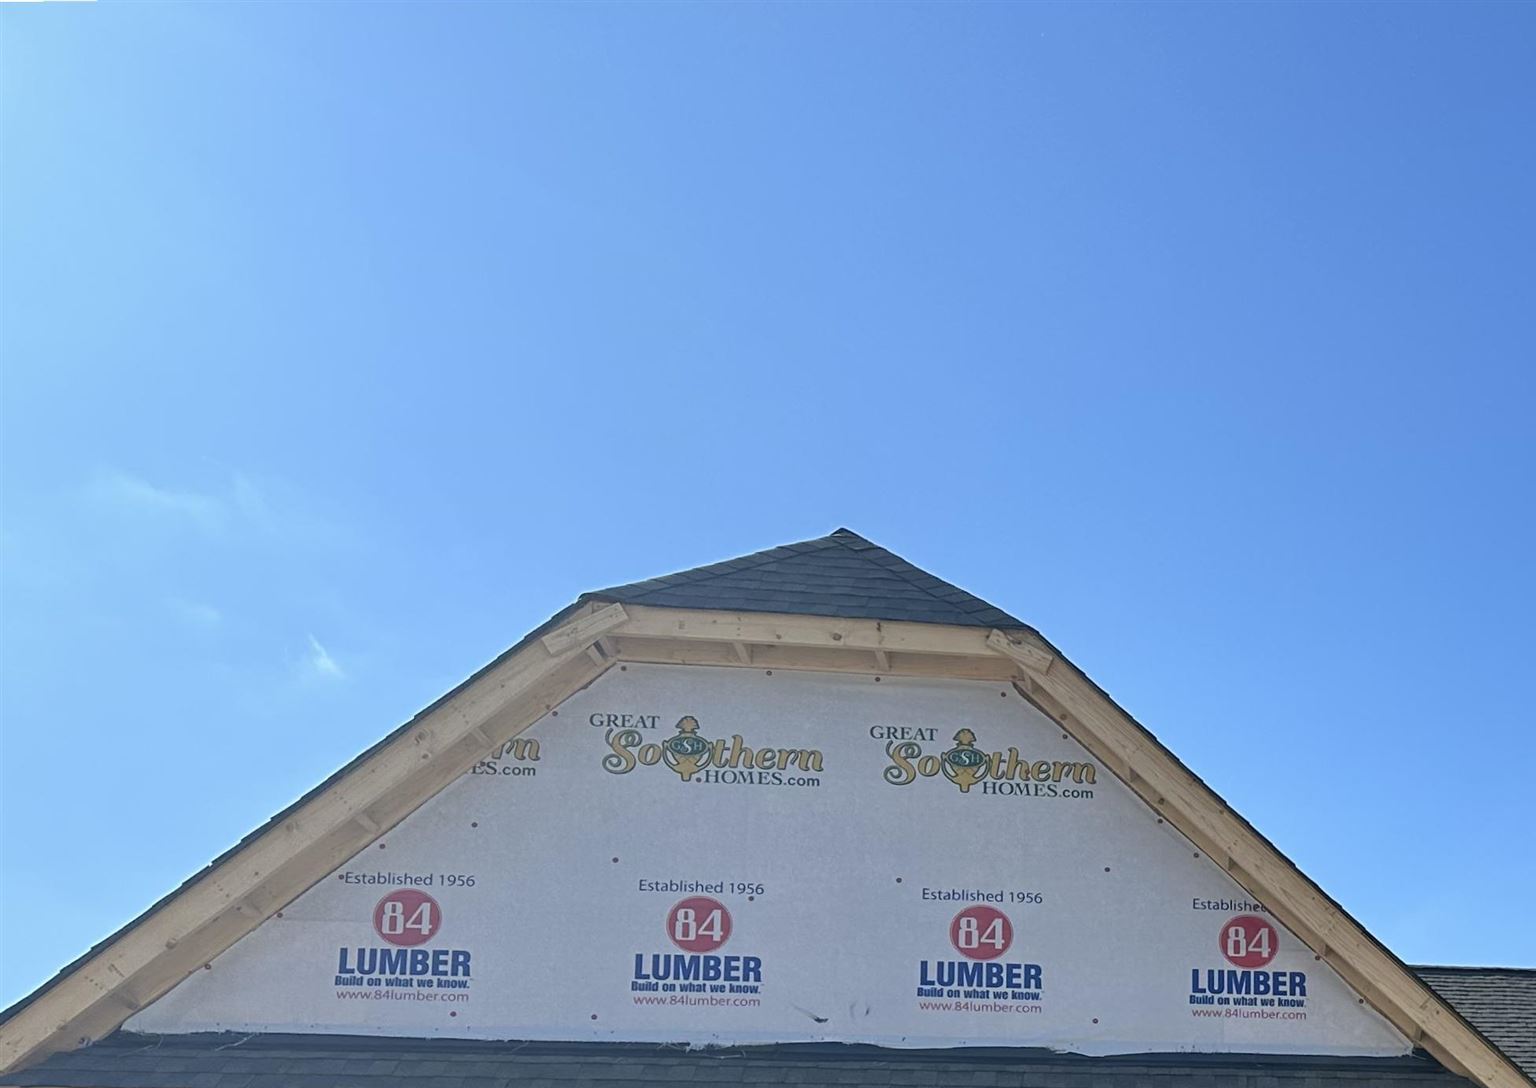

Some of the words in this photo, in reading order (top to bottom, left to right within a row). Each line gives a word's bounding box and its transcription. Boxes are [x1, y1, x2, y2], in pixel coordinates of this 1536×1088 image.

[589, 712, 660, 729] GREAT
[870, 725, 938, 741] GREAT
[602, 727, 824, 775] Southern
[883, 740, 1097, 786] Southern
[703, 770, 820, 787] HOMES.com
[982, 781, 1094, 799] HOMES.com
[345, 872, 433, 886] Established
[440, 874, 476, 887] 1956
[639, 879, 723, 894] Established
[730, 882, 764, 895] 1956
[922, 888, 1004, 902] Established
[1010, 892, 1042, 904] 1956
[382, 902, 432, 935] 84
[675, 908, 723, 941] 84
[959, 917, 1004, 950] 84
[1227, 927, 1271, 958] 84
[338, 948, 471, 976] LUMBER
[634, 954, 762, 982] LUMBER
[335, 976, 363, 986] Build
[367, 978, 381, 986] on
[385, 977, 413, 988] what
[417, 979, 433, 988] we
[437, 978, 470, 988] know.
[920, 960, 1042, 989] LUMBER
[1192, 969, 1307, 996] LUMBER
[336, 990, 469, 1002] www.84lumber.com
[631, 981, 658, 992] Build
[662, 983, 676, 992] on
[680, 983, 706, 993] what
[710, 984, 726, 993] we
[729, 984, 760, 994] know.
[917, 988, 944, 998] Build
[947, 989, 960, 998] on
[964, 989, 990, 999] what
[993, 991, 1008, 1000] we
[1012, 990, 1042, 1000] know.
[633, 995, 760, 1007] www.84lumber.com
[920, 1002, 1042, 1014] www.84lumber.com
[1190, 995, 1214, 1004] Build
[1218, 997, 1230, 1005] on
[1233, 996, 1257, 1006] what
[1261, 998, 1275, 1007] we
[1192, 1008, 1306, 1020] www.84lumber.com
